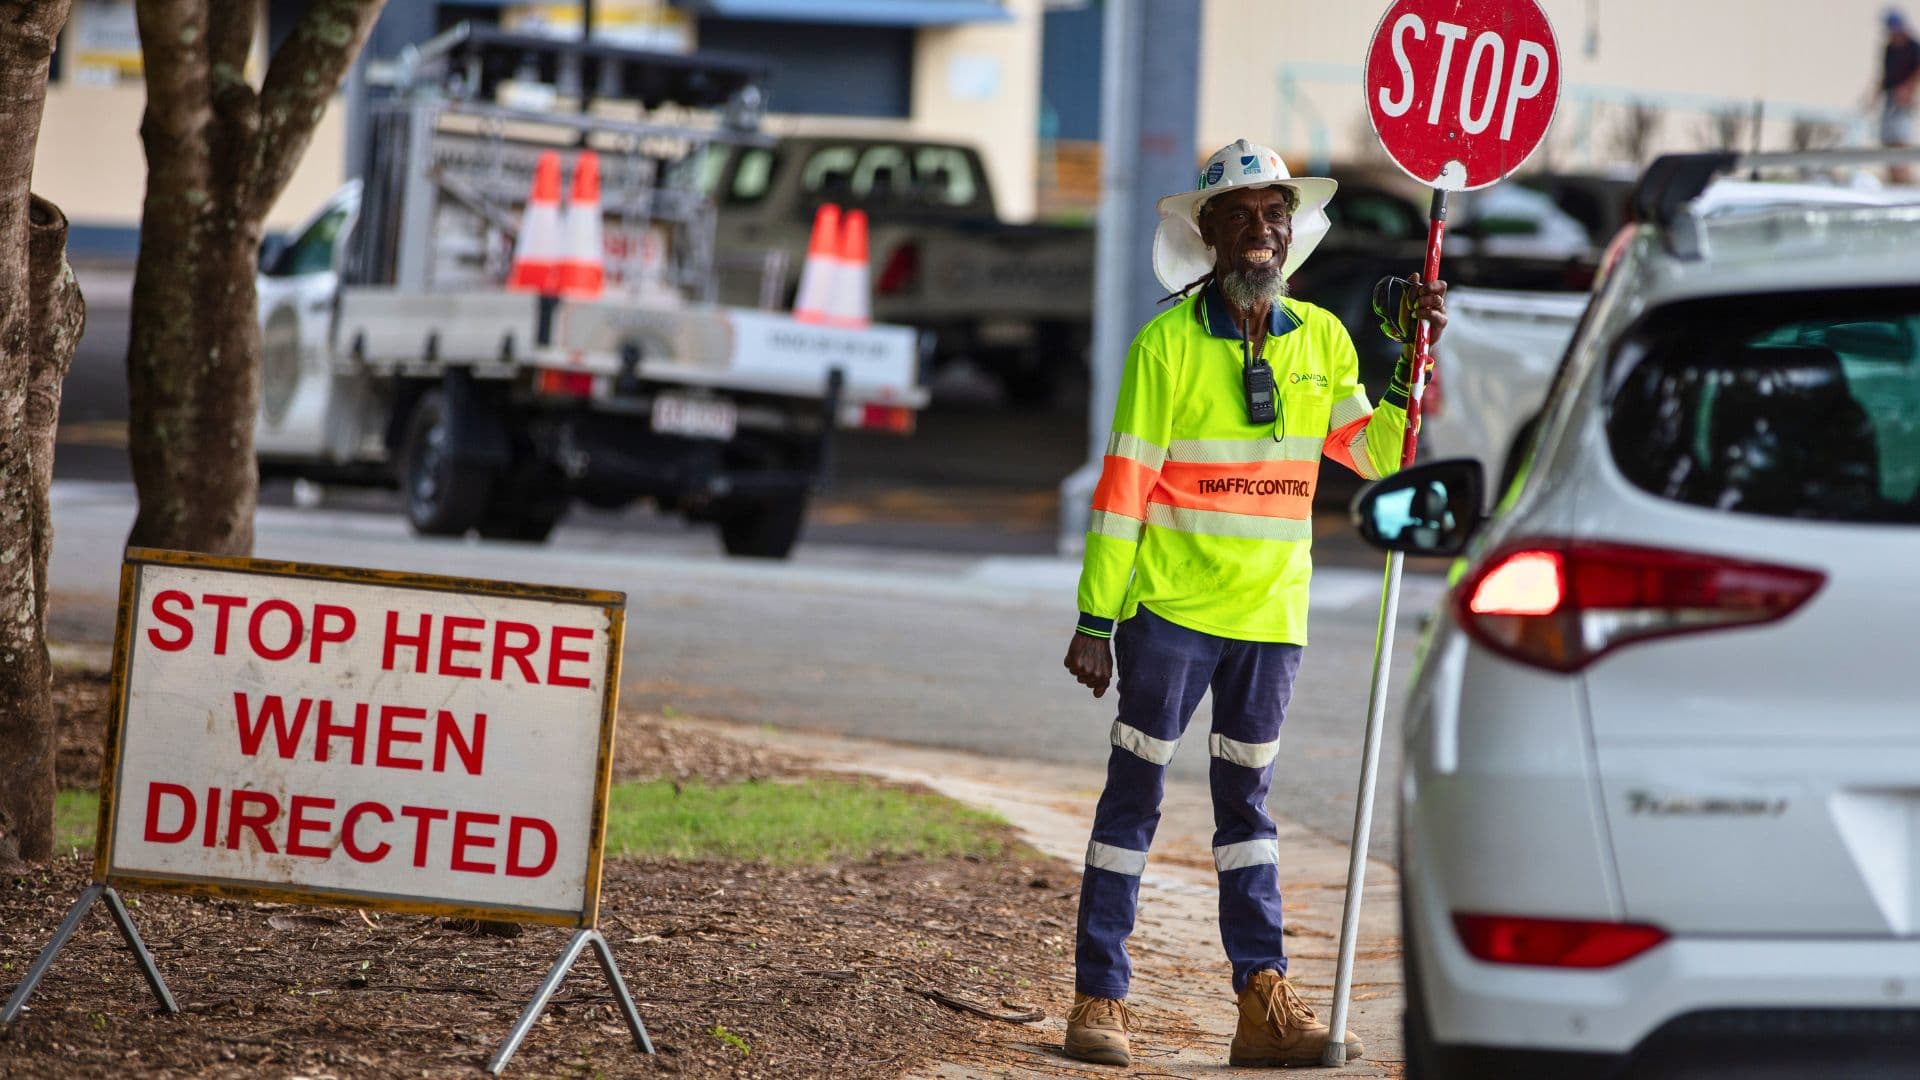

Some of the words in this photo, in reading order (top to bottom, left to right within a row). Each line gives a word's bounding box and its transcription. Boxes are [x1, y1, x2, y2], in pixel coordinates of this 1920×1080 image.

[1378, 13, 1549, 141] STOP
[1198, 478, 1256, 495] TRAFFIC
[147, 590, 357, 664] STOP
[381, 610, 595, 689] HERE
[233, 692, 487, 776] WHEN
[143, 781, 559, 878] DIRECTED
